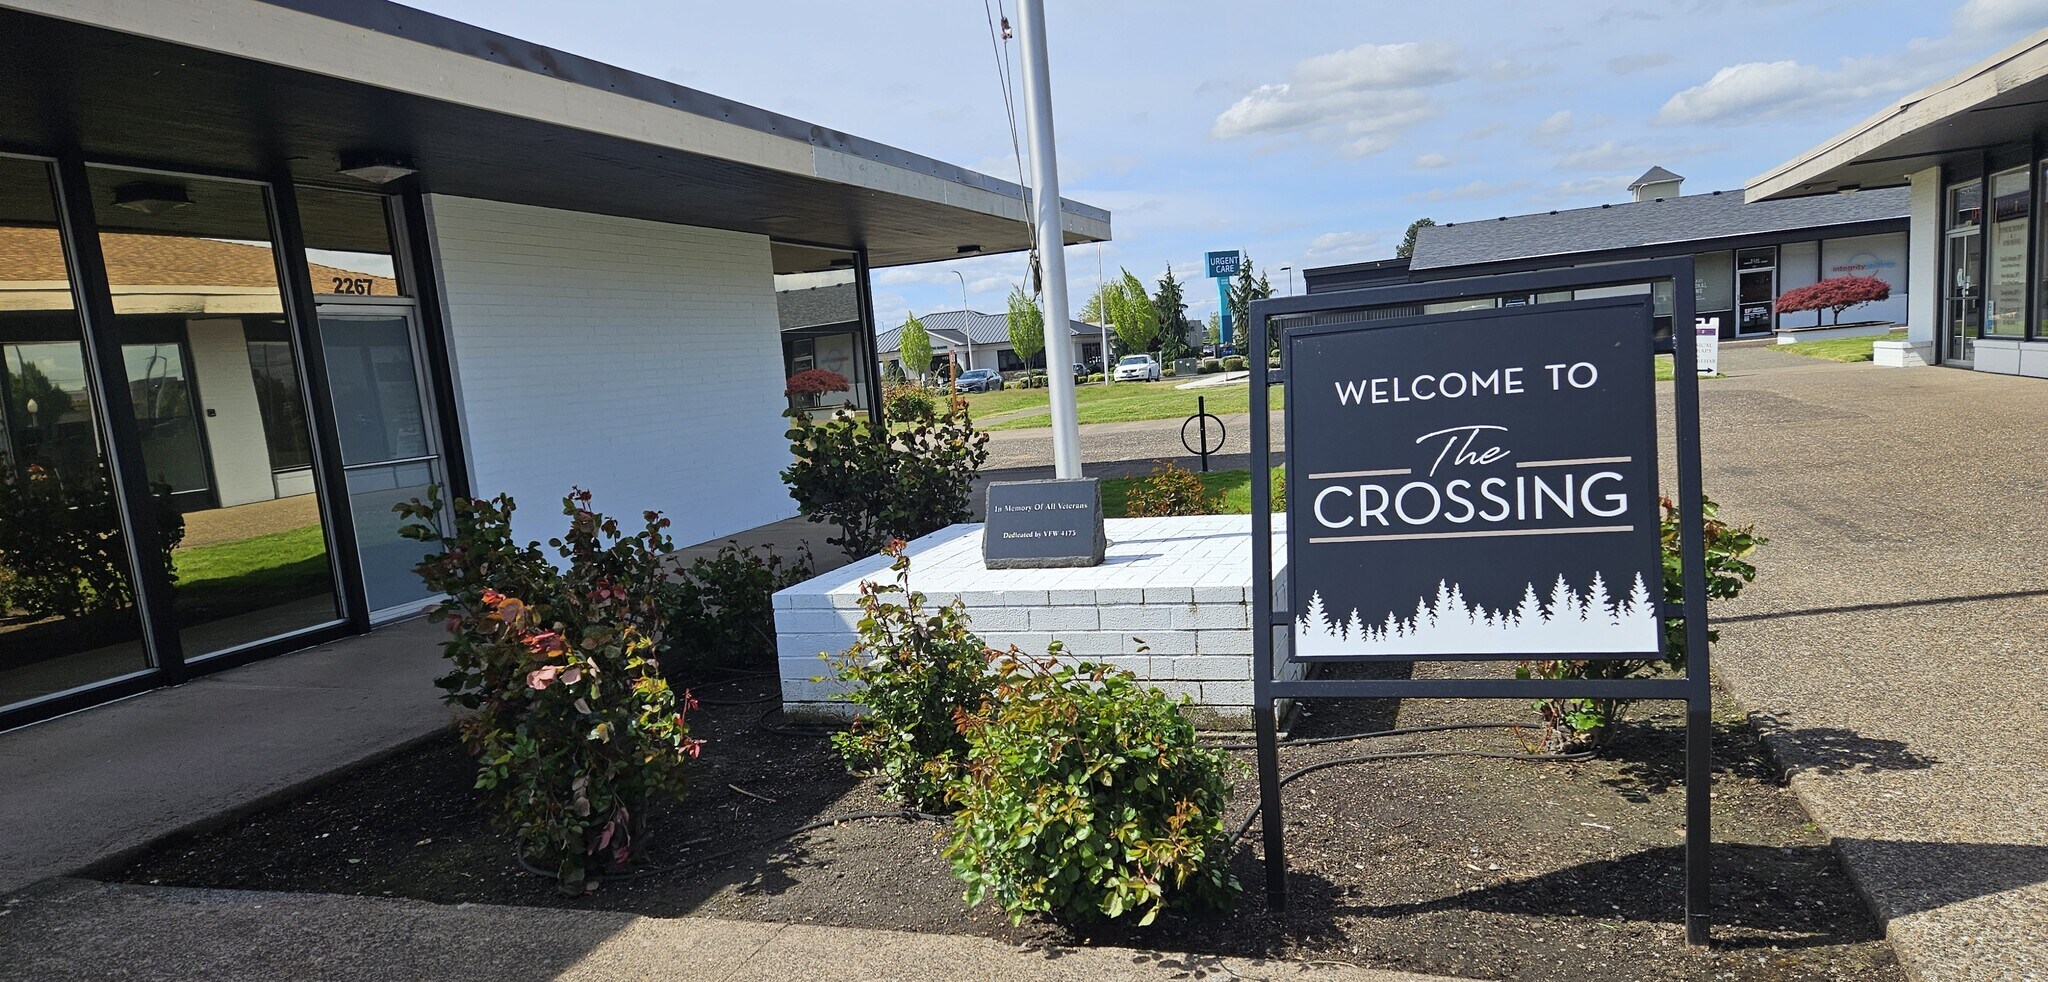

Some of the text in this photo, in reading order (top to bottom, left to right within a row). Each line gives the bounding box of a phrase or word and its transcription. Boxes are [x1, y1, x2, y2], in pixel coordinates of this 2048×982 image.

[1210, 256, 1238, 265] URGENT
[1216, 265, 1234, 273] CARE
[1832, 263, 1866, 273] integrity
[332, 273, 373, 296] 2267
[1334, 361, 1598, 406] WELCOME TO
[1416, 424, 1511, 478] The
[1313, 471, 1628, 529] CROSSING
[994, 502, 1088, 513] In Memory Of All Veterans
[1003, 531, 1033, 539] Dedicated
[1034, 530, 1042, 539] by
[1043, 530, 1060, 538] VFW
